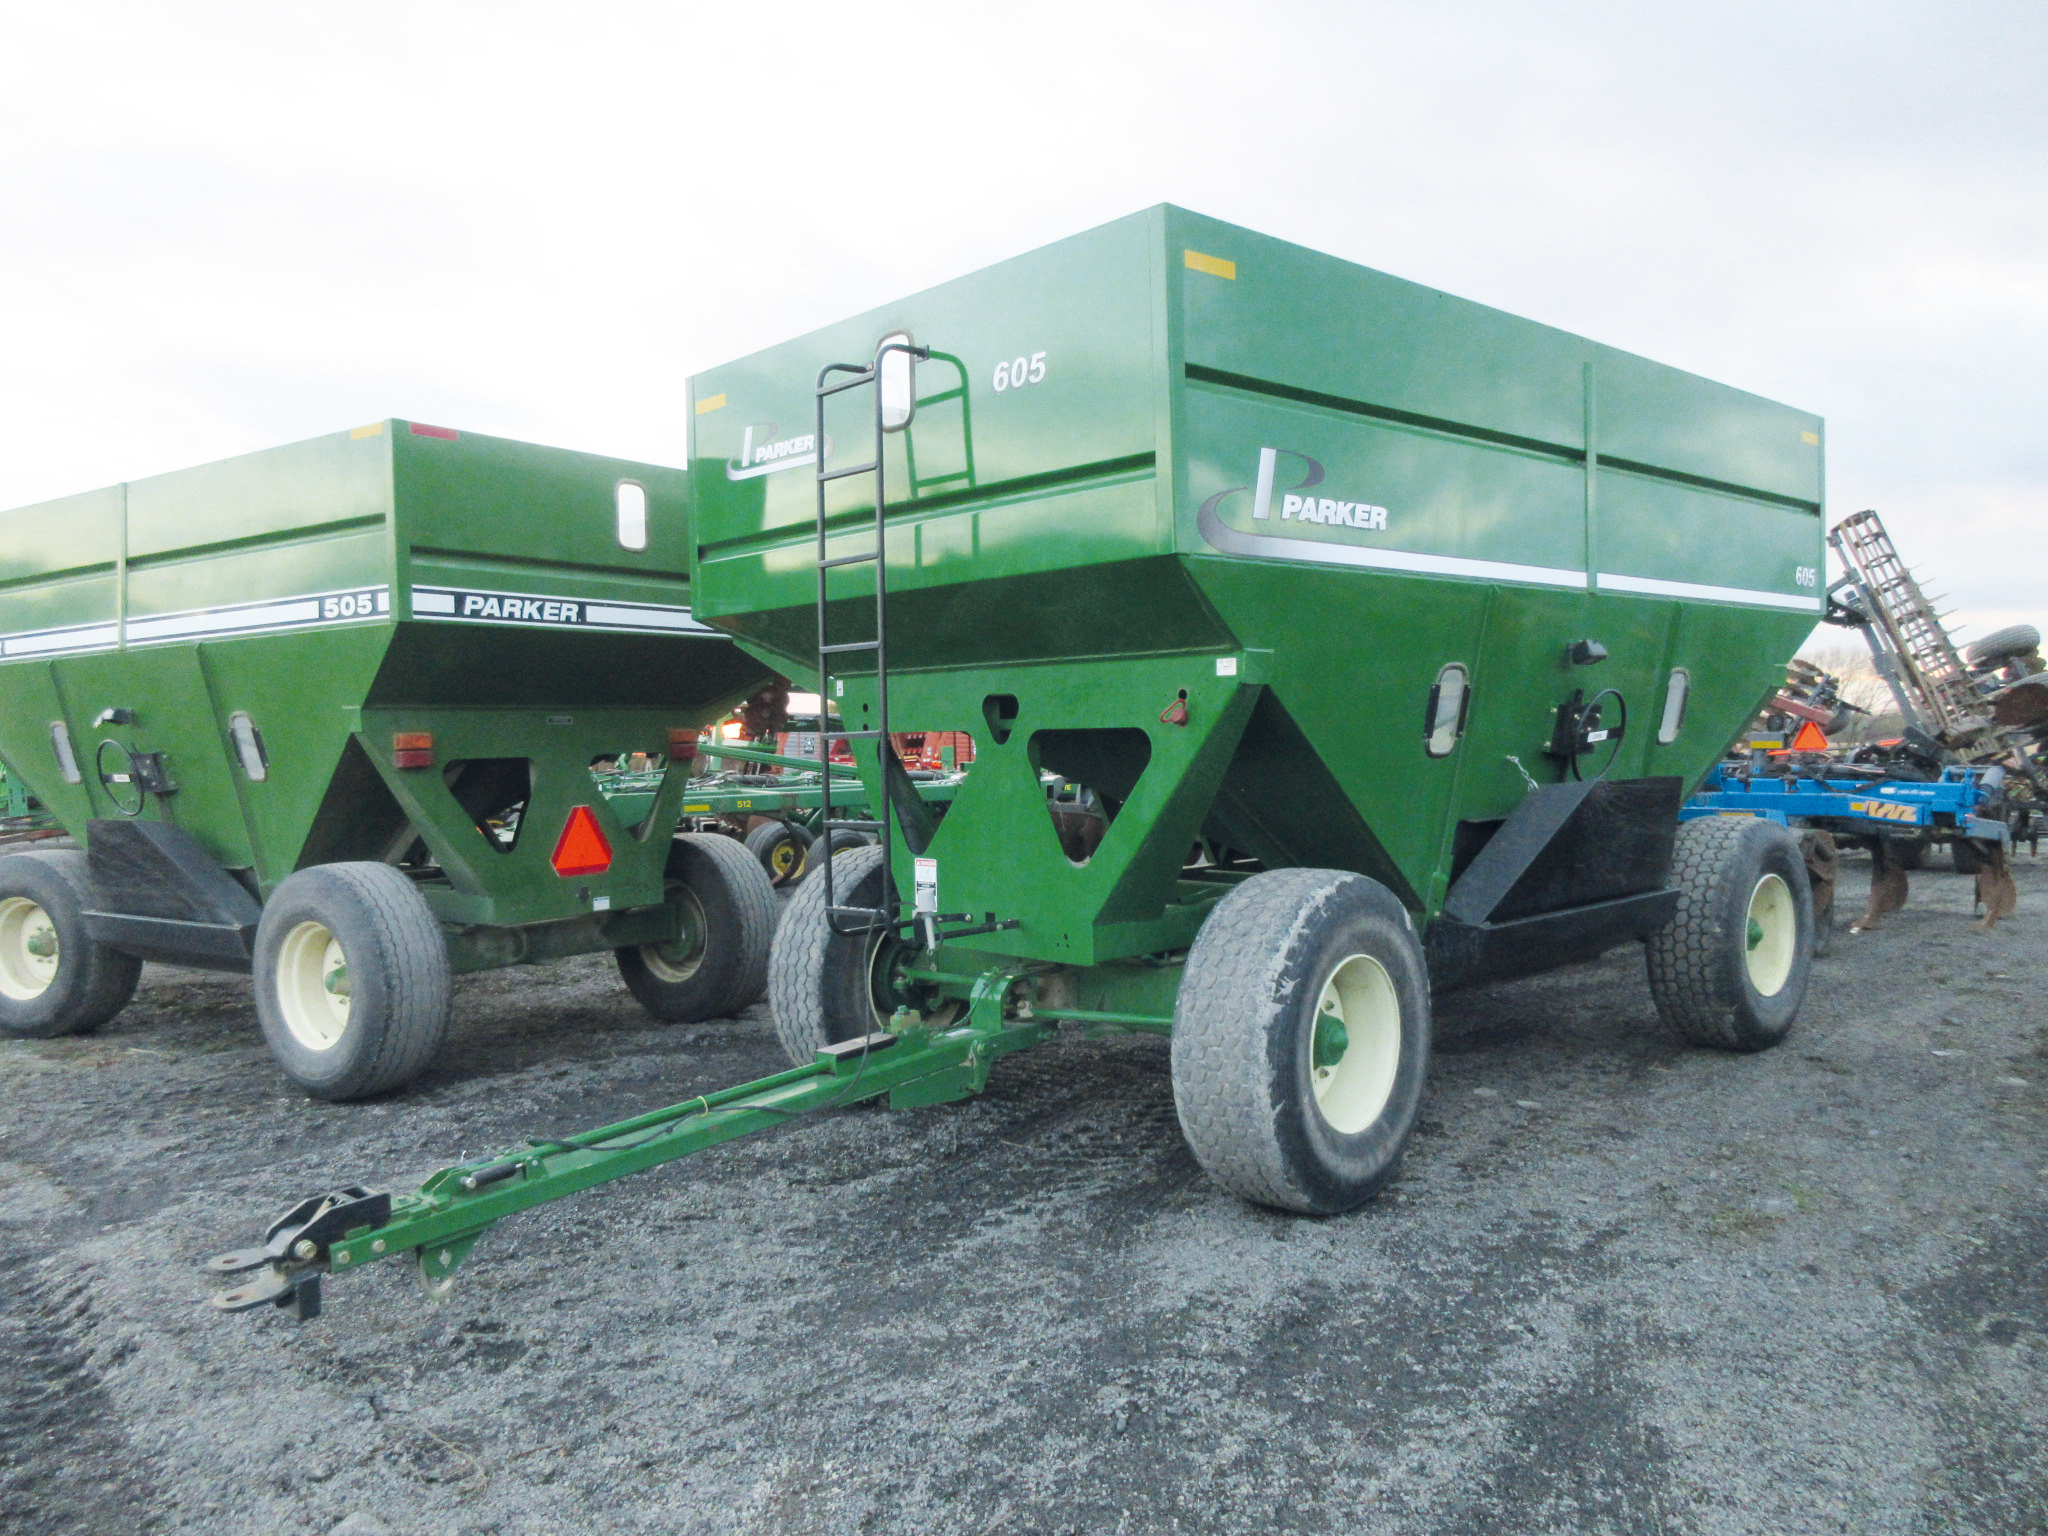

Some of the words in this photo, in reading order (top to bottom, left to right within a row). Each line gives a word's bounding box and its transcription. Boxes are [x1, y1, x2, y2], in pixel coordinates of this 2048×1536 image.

[992, 351, 1046, 394] 605
[755, 434, 815, 464] PARKER
[1281, 494, 1388, 530] PARKER
[1795, 566, 1815, 588] 605
[323, 594, 373, 618] 505
[463, 595, 579, 622] PARKER
[736, 800, 752, 808] 512
